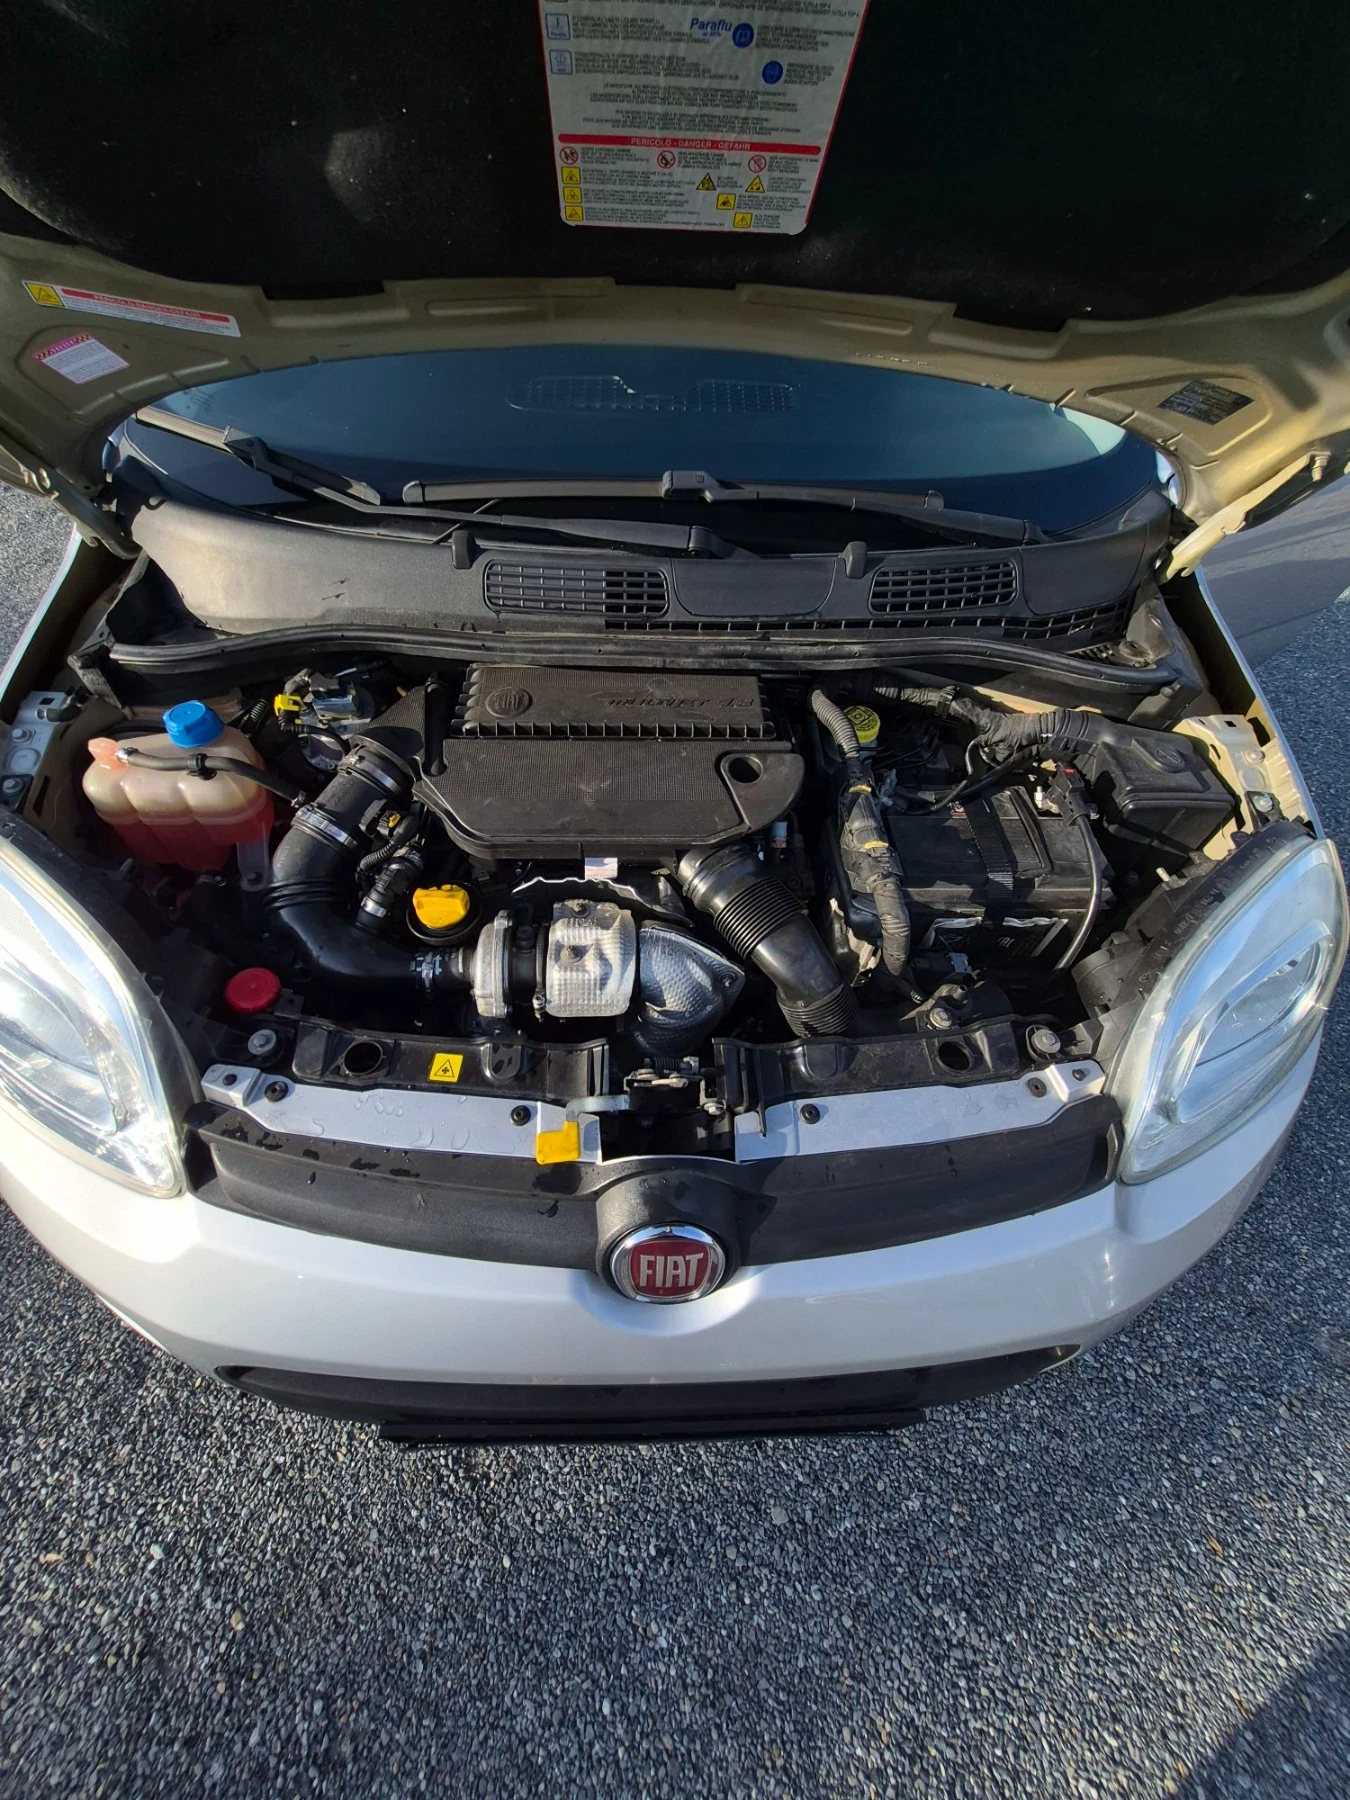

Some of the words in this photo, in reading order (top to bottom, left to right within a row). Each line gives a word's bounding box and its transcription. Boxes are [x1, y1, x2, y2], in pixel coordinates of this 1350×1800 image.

[690, 17, 733, 32] Paraflu
[630, 137, 671, 147] PERICOLO
[678, 139, 711, 149] DANGER
[718, 142, 751, 151] GEFAHR
[639, 1253, 704, 1288] FIAT
